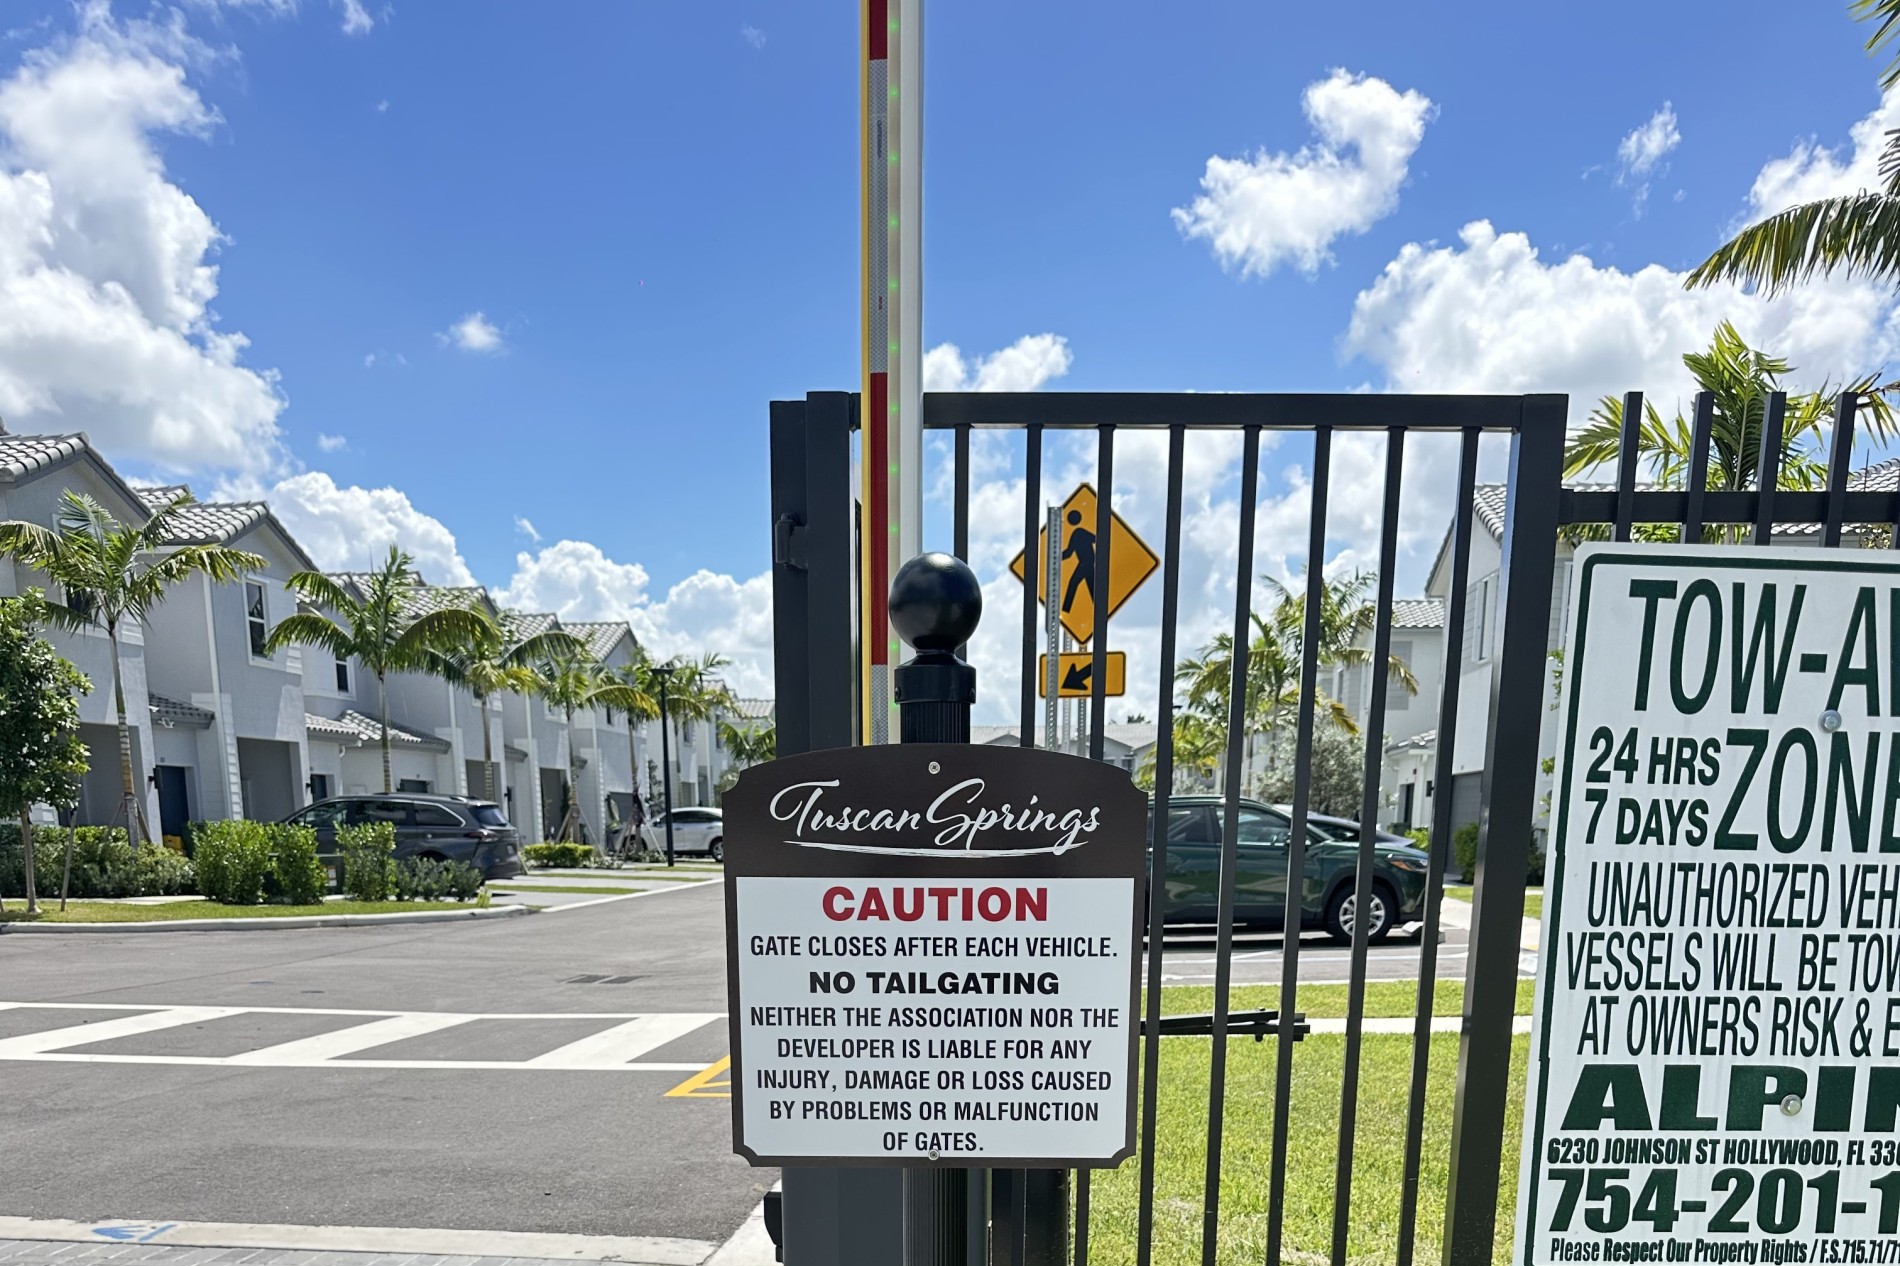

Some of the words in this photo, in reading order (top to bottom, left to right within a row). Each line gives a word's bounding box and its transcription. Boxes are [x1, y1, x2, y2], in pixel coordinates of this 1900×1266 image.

[1629, 578, 1900, 718] TOW-A
[1585, 725, 1639, 784] 24
[1647, 736, 1722, 787] HRS
[769, 778, 921, 838] Tuscan
[925, 777, 1101, 857] Springs
[1584, 788, 1609, 845] 7
[1615, 797, 1709, 848] DAYS
[822, 886, 1048, 922] CAUTION
[1587, 861, 1830, 929] UNAUTHORIZED
[1839, 863, 1900, 929] VEH
[750, 935, 802, 957] GATE
[808, 935, 887, 957] CLOSES
[893, 936, 958, 957] AFTER
[965, 936, 1019, 957] EACH
[1025, 936, 1118, 958] VEHICLE.
[1566, 931, 1703, 992] VESSELS
[1712, 932, 1783, 992] WILL
[1797, 933, 1841, 992] BE
[809, 971, 856, 995] NO
[865, 971, 1059, 995] TAILGATING
[750, 1006, 837, 1027] NEITHER
[842, 1007, 882, 1027] THE
[887, 1007, 1023, 1028] ASSOCIATION
[1030, 1007, 1073, 1028] NOR
[1079, 1008, 1119, 1028] THE
[1576, 995, 1620, 1056] AT
[1626, 995, 1761, 1057] OWNERS
[1769, 996, 1845, 1058] RISK
[1849, 997, 1873, 1058] &
[777, 1038, 895, 1059] DEVELOPER
[902, 1038, 921, 1059] IS
[928, 1039, 997, 1059] LIABLE
[1003, 1039, 1044, 1060] FOR
[1049, 1039, 1092, 1060] ANY
[757, 1069, 837, 1093] INJURY,
[845, 1070, 930, 1090] DAMAGE
[937, 1070, 965, 1091] OR
[972, 1070, 1024, 1091] LOSS
[1031, 1070, 1112, 1091] CAUSED
[769, 1100, 796, 1120] BY
[802, 1100, 912, 1121] PROBLEMS
[919, 1101, 947, 1121] OR
[954, 1101, 1099, 1122] MALFUNCTION
[882, 1131, 909, 1151] OF
[915, 1131, 984, 1152] GATES.
[1547, 1137, 1600, 1165] 6230
[1602, 1137, 1692, 1165] JOHNSON
[1695, 1138, 1721, 1165] ST
[1723, 1138, 1842, 1168] HOLLYWOOD,
[1846, 1140, 1866, 1166] FL
[1547, 1167, 1900, 1235] 754-201-1
[1550, 1237, 1600, 1262] Please
[1603, 1238, 1664, 1265] Respect
[1666, 1237, 1693, 1263] Our
[1694, 1238, 1759, 1265] Property
[1760, 1238, 1808, 1266] Rights
[1809, 1238, 1819, 1264] /
